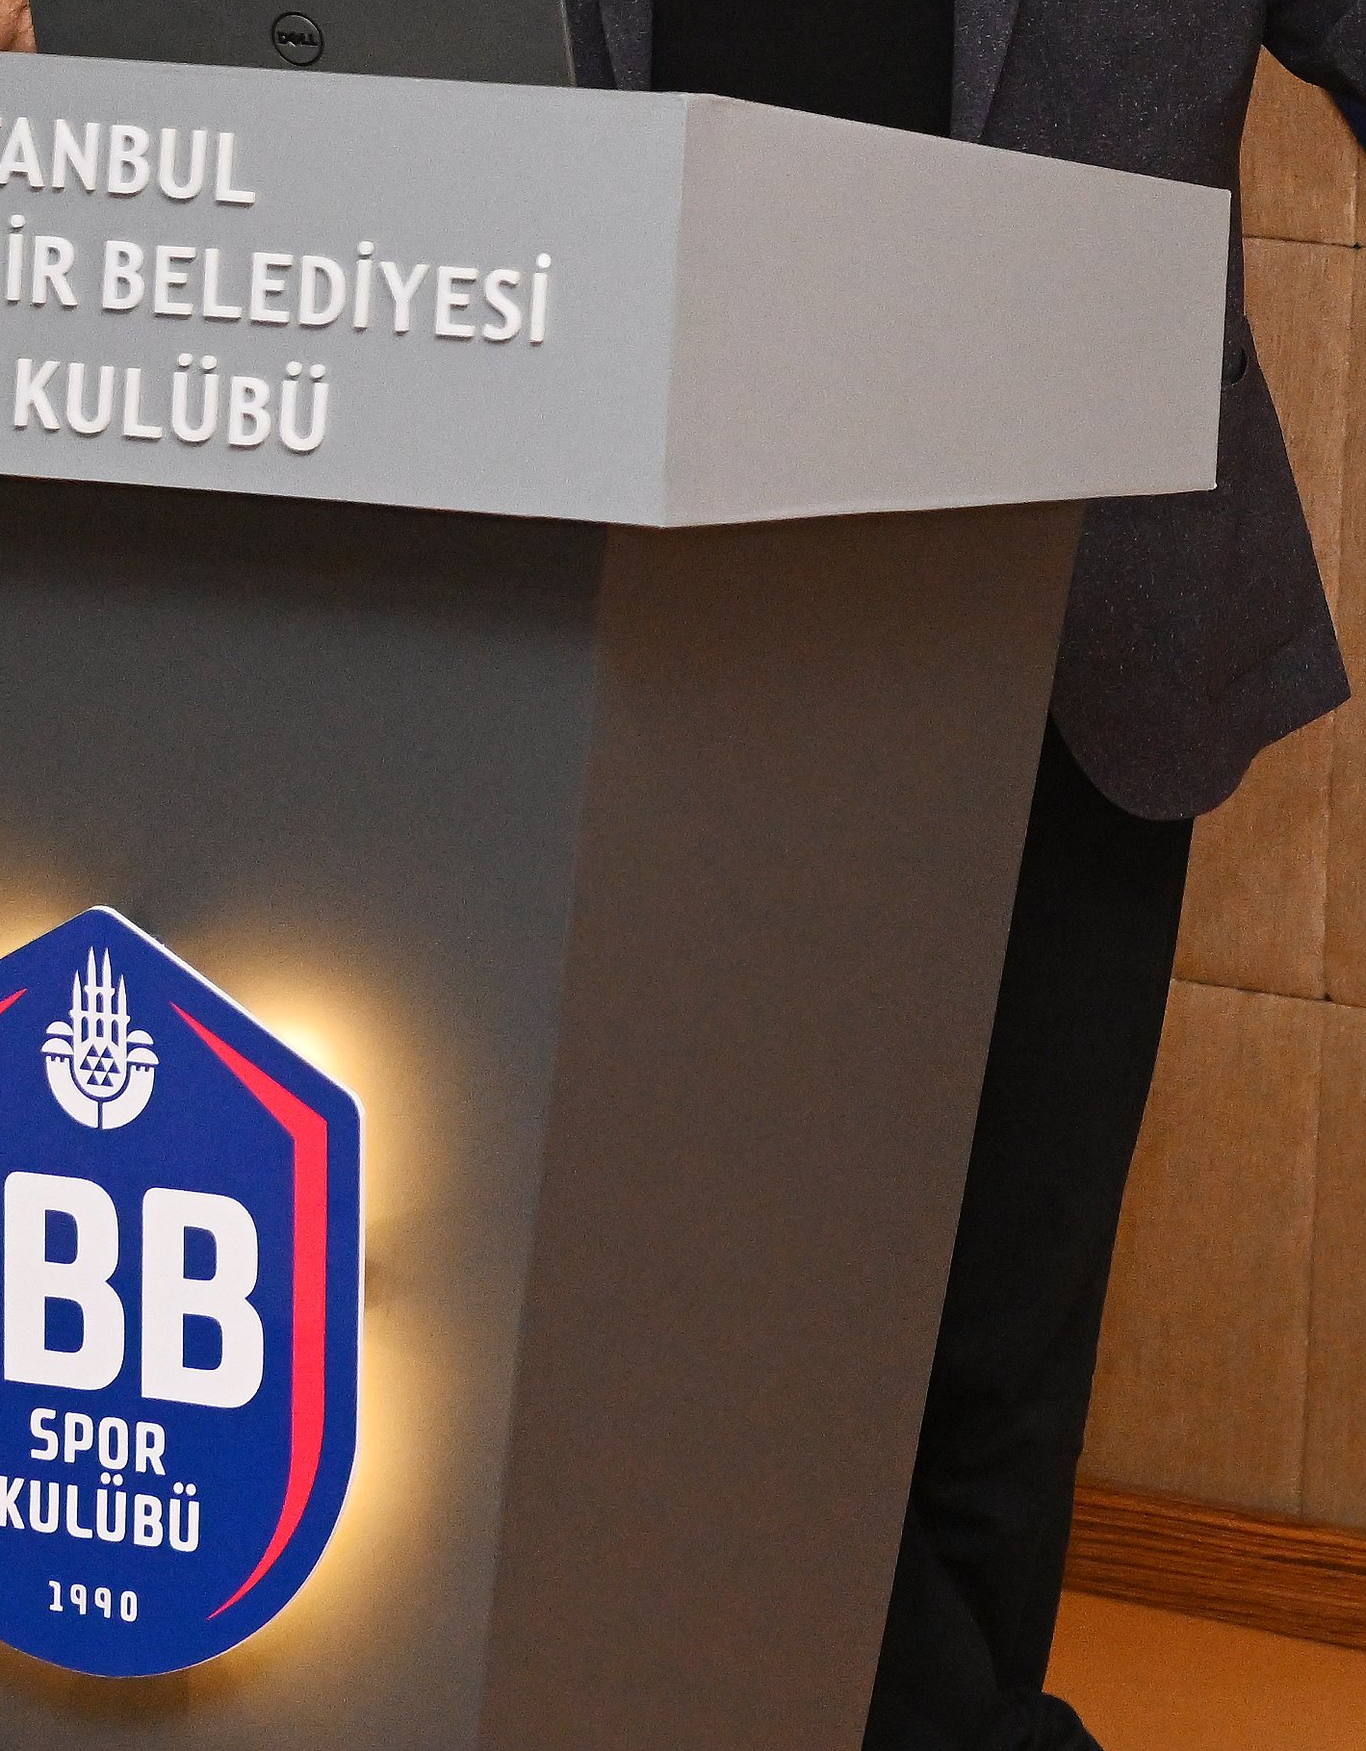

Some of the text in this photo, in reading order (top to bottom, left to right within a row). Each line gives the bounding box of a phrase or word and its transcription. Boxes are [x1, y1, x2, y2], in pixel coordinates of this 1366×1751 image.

[276, 30, 319, 47] DELL
[100, 240, 551, 346] BELEDİYESİ
[12, 351, 331, 455] KULÜBÜ
[30, 1407, 167, 1477] SPOR
[48, 1579, 140, 1624] 1990
